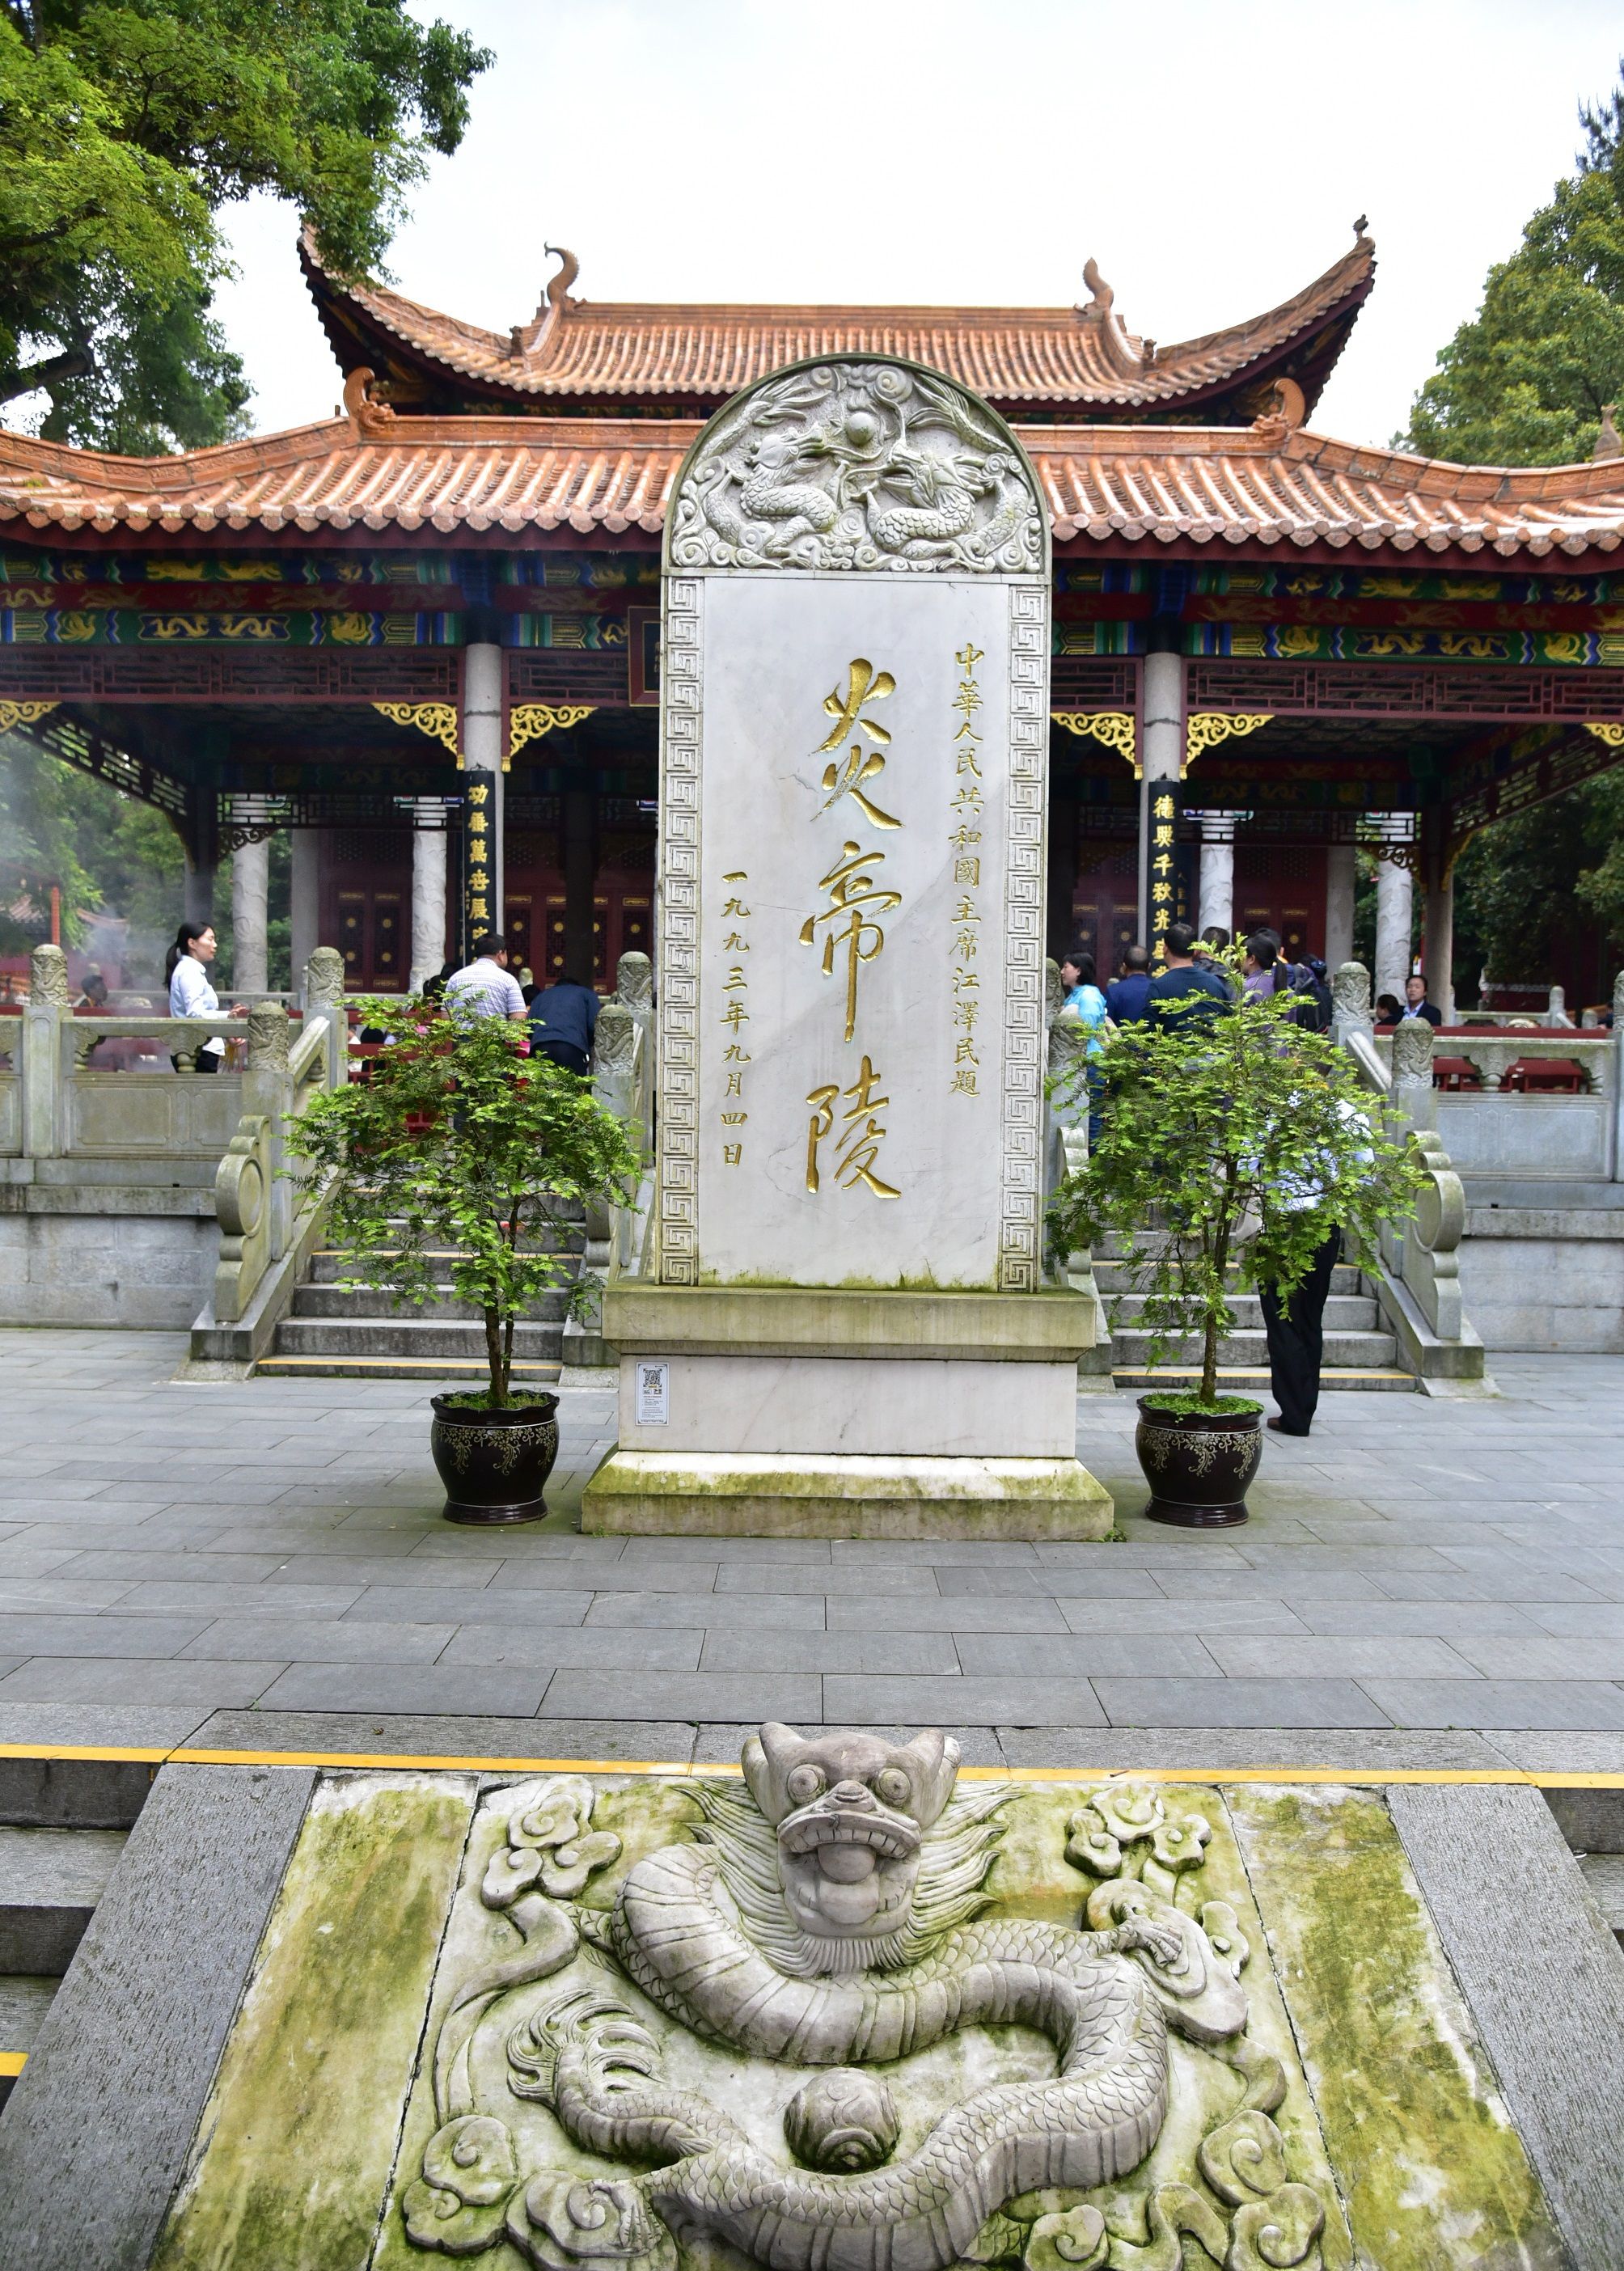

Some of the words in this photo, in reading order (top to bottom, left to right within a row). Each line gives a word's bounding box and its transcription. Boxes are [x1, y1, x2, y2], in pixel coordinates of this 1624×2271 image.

[719, 870, 751, 1166] 一九九三年九月四日
[798, 657, 903, 1199] 炎帝陵
[948, 642, 985, 1097] 中華人民共和國主席江澤民題
